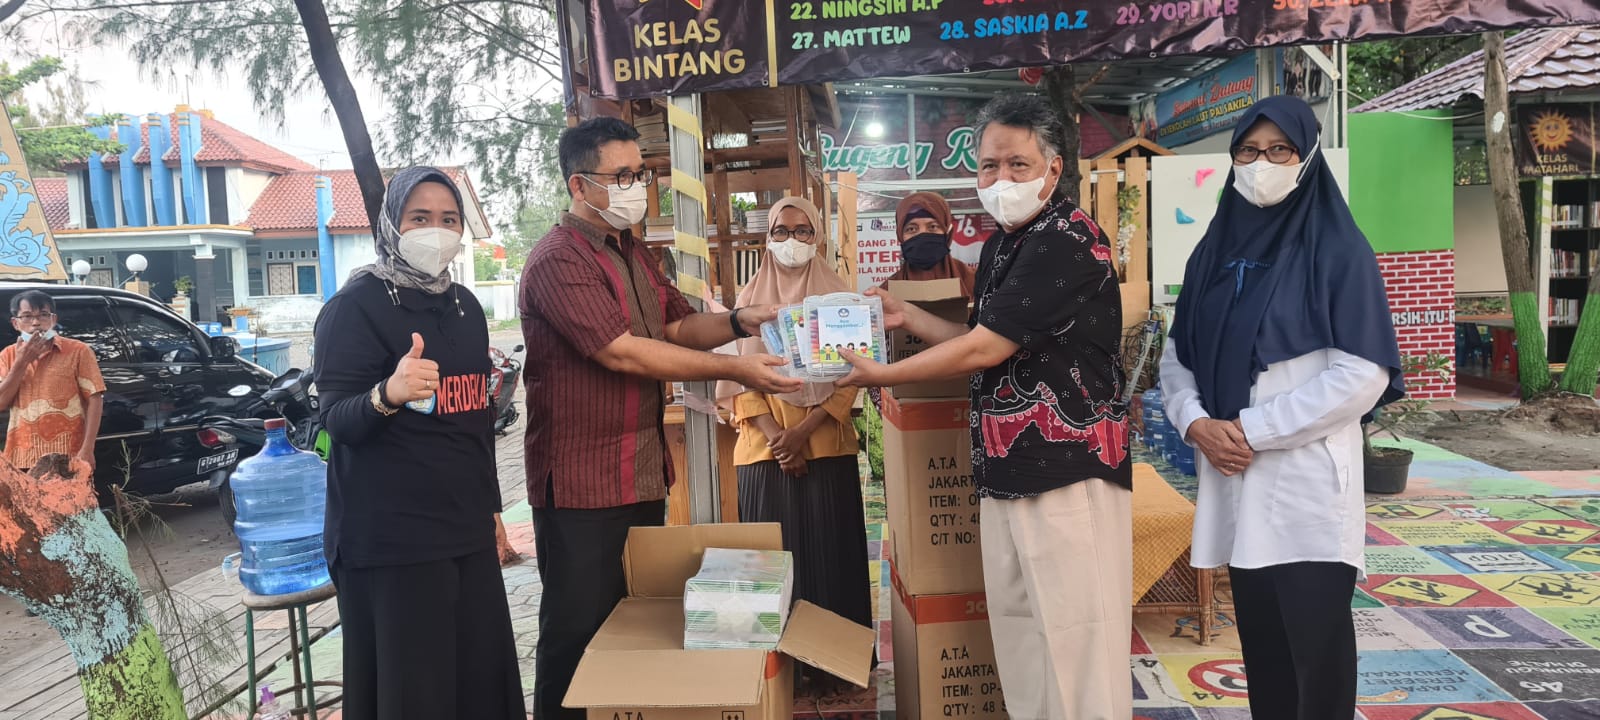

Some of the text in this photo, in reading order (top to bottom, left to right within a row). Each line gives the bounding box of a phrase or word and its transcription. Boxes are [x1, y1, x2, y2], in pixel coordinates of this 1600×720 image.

[790, 3, 817, 20] 22.
[822, 0, 907, 19] NINGSIH
[940, 10, 1089, 40] 28. SASKIA A.Z
[633, 18, 721, 49] KELAS
[791, 25, 911, 50] 27. MATTEW
[613, 49, 746, 82] BINTANG
[1536, 153, 1568, 164] KELAS
[1523, 163, 1579, 175] MATAHARI
[857, 251, 900, 264] ITER
[1424, 310, 1444, 324] ITU
[436, 373, 487, 415] MERDEKA
[928, 457, 957, 471] A.T.A
[929, 494, 961, 508] ITEM:
[930, 532, 976, 546] C/T NO:
[1469, 553, 1525, 562] STOP
[941, 645, 969, 661] A.T.A
[941, 664, 995, 680] JAKARTA
[942, 685, 974, 698] ITEM:
[1519, 681, 1564, 693] 46
[982, 701, 995, 713] 48
